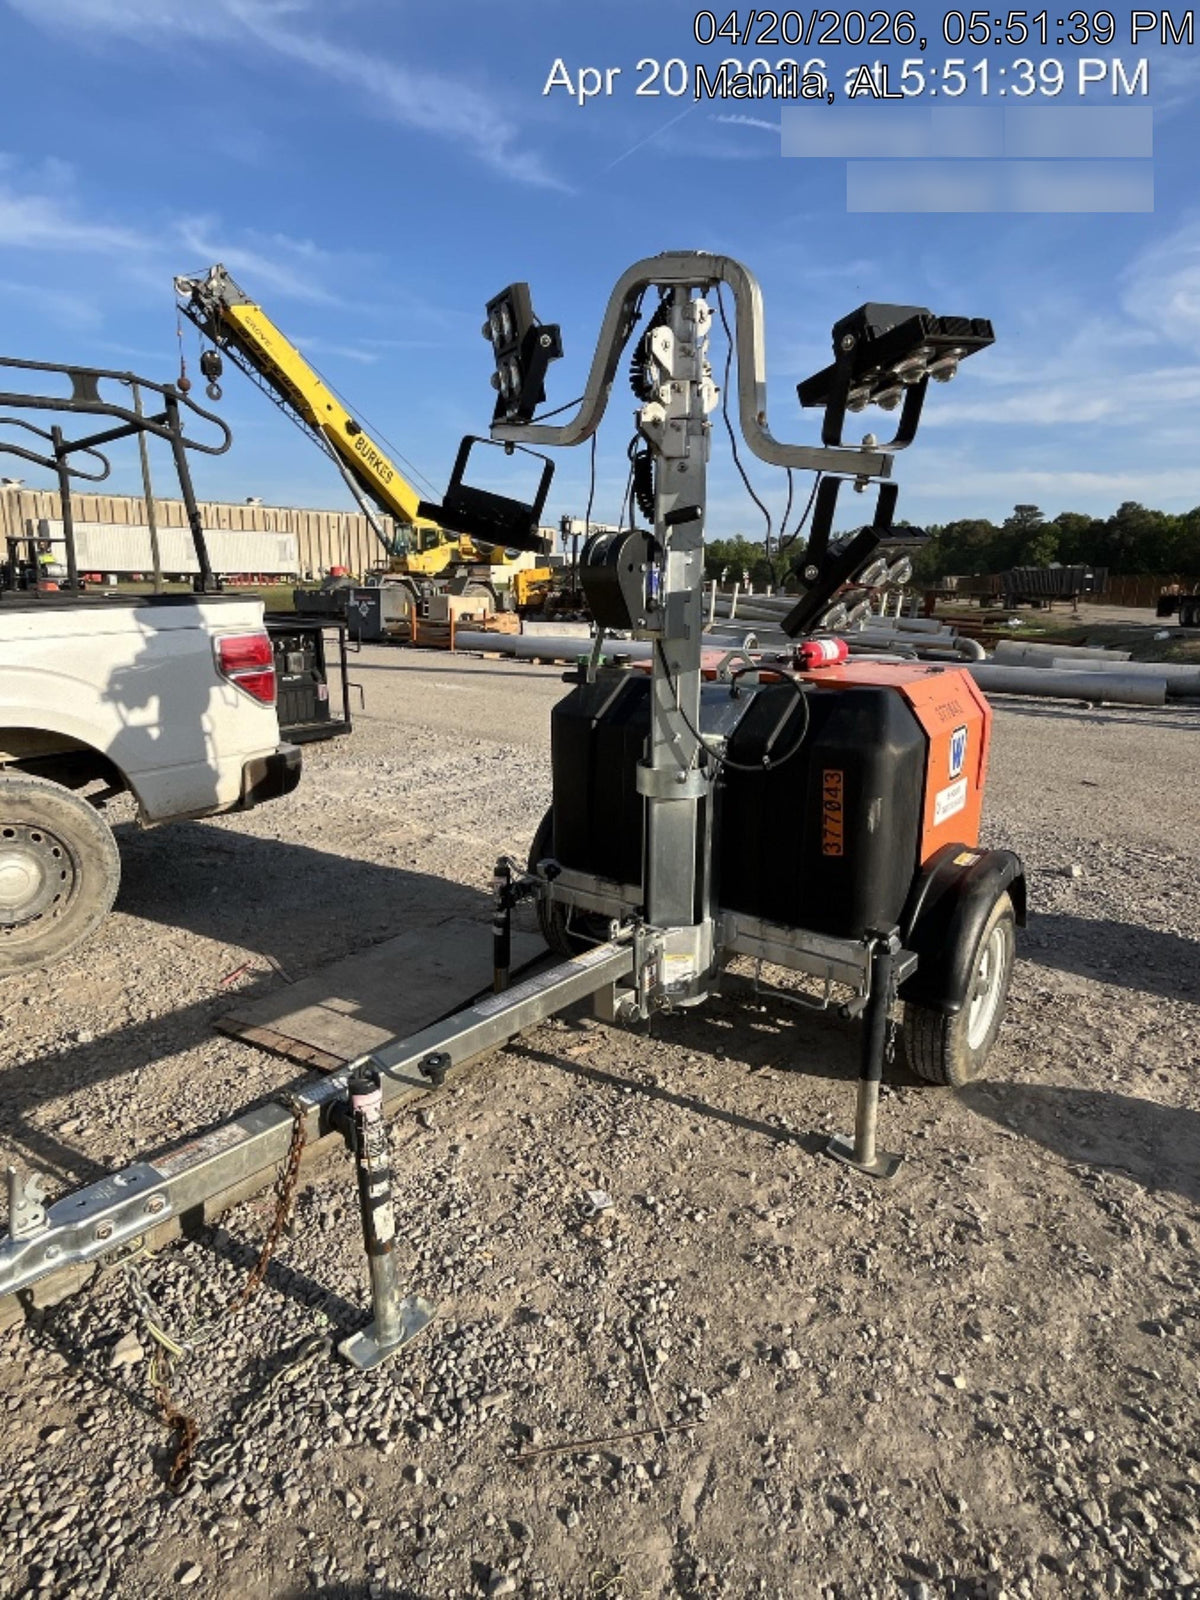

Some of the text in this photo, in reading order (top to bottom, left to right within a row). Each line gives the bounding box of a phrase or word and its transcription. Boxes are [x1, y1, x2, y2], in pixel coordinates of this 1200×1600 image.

[244, 315, 272, 348] GROVE
[354, 436, 394, 484] BURKES
[823, 772, 843, 854] 377043
